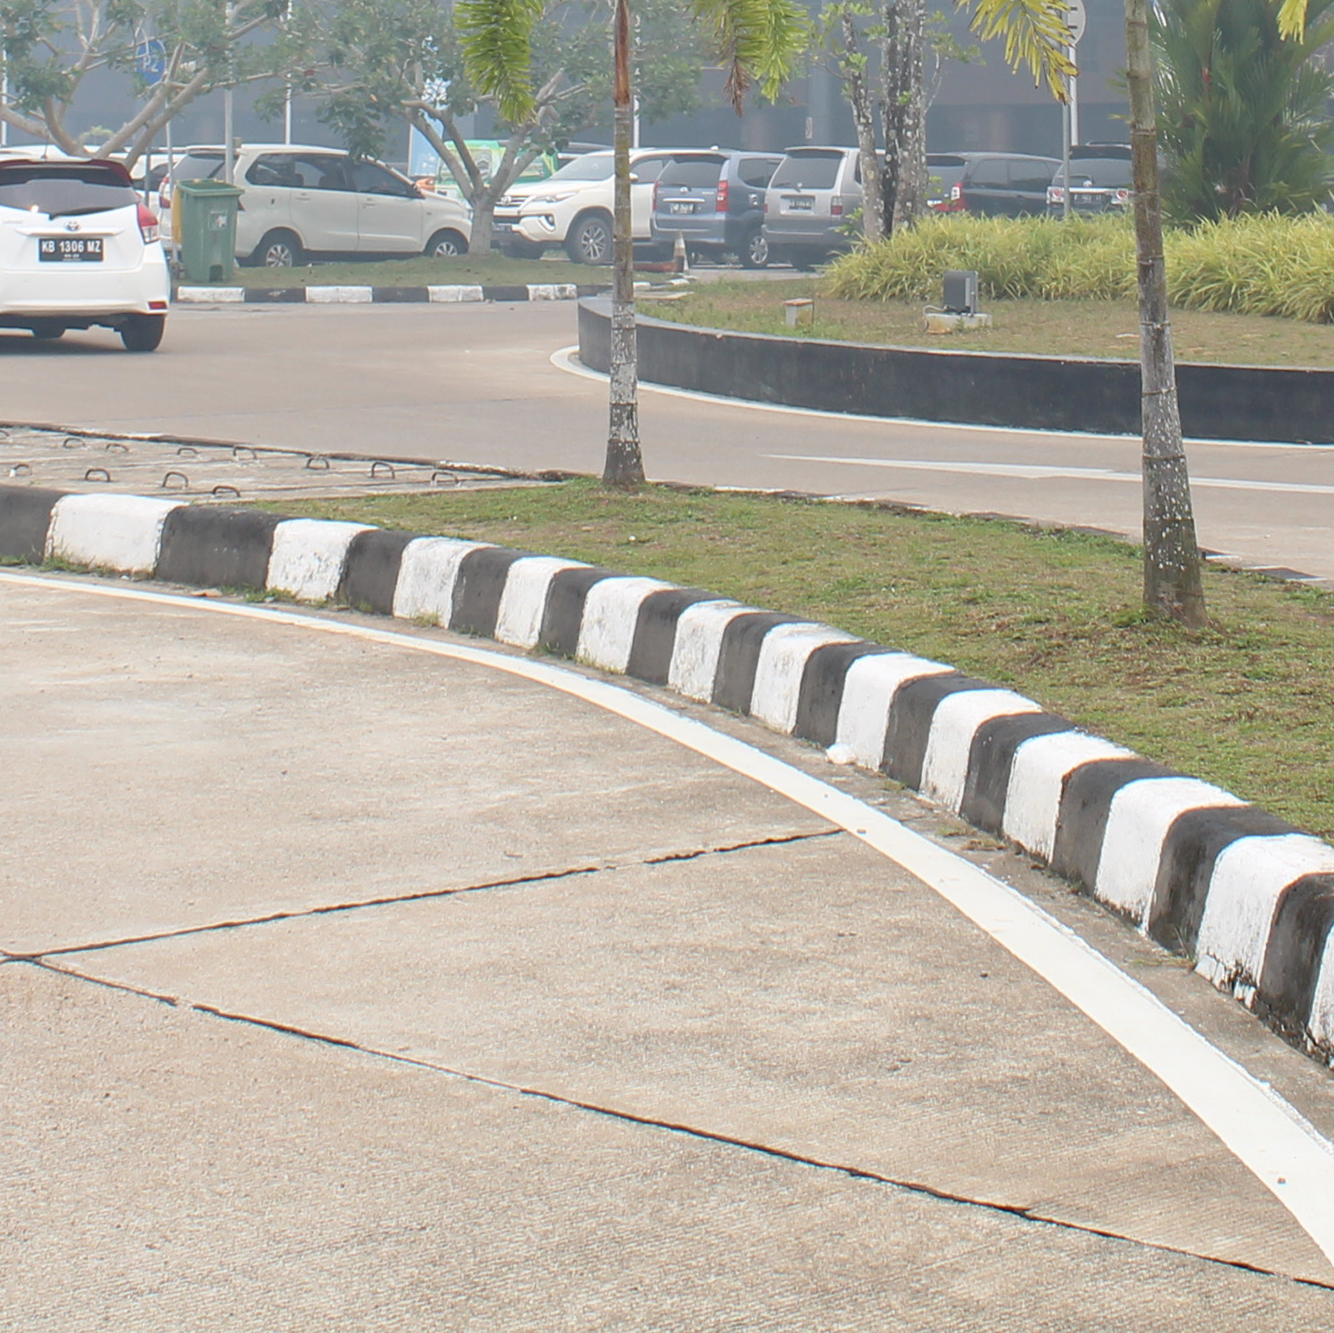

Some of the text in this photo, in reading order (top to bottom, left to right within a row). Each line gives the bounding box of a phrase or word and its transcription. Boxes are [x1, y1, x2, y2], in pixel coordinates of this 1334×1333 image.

[41, 240, 101, 253] KB 1306 MZ
